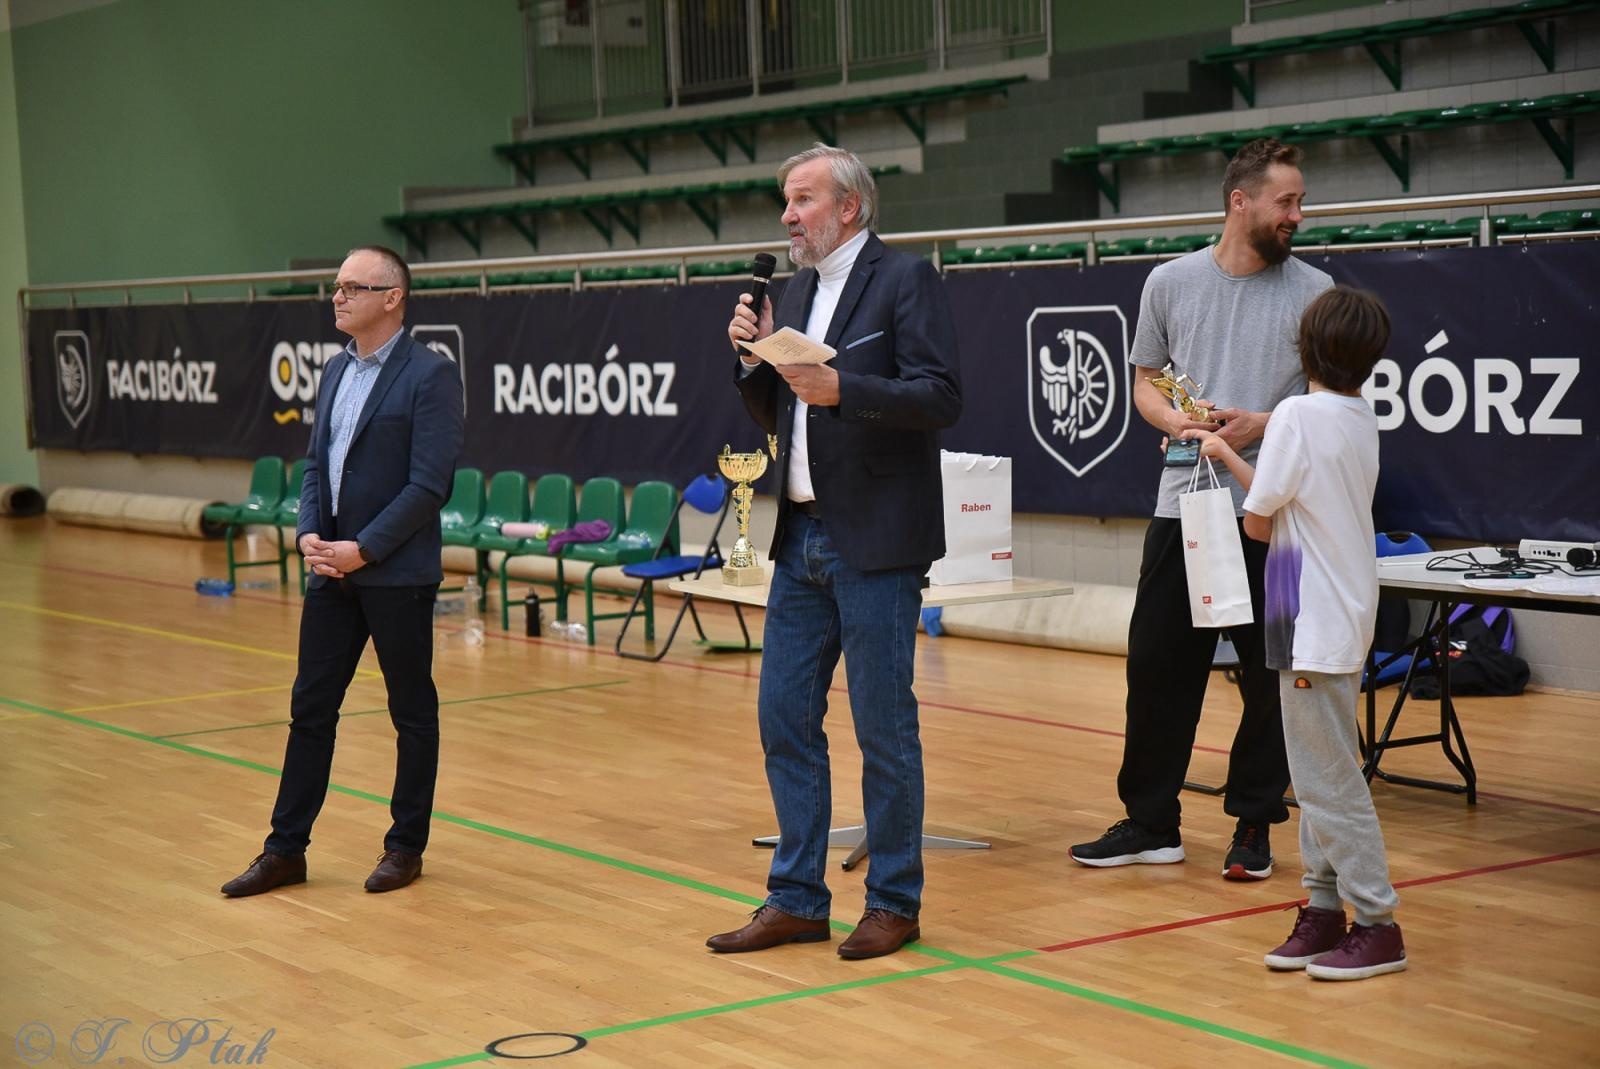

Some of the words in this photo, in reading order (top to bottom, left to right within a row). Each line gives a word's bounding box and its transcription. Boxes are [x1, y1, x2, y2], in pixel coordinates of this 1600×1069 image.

[106, 346, 218, 403] RACIBÓRZ
[494, 344, 679, 417] RACIBÓRZ
[1361, 329, 1583, 436] BÓRZ
[960, 503, 991, 513] Raben
